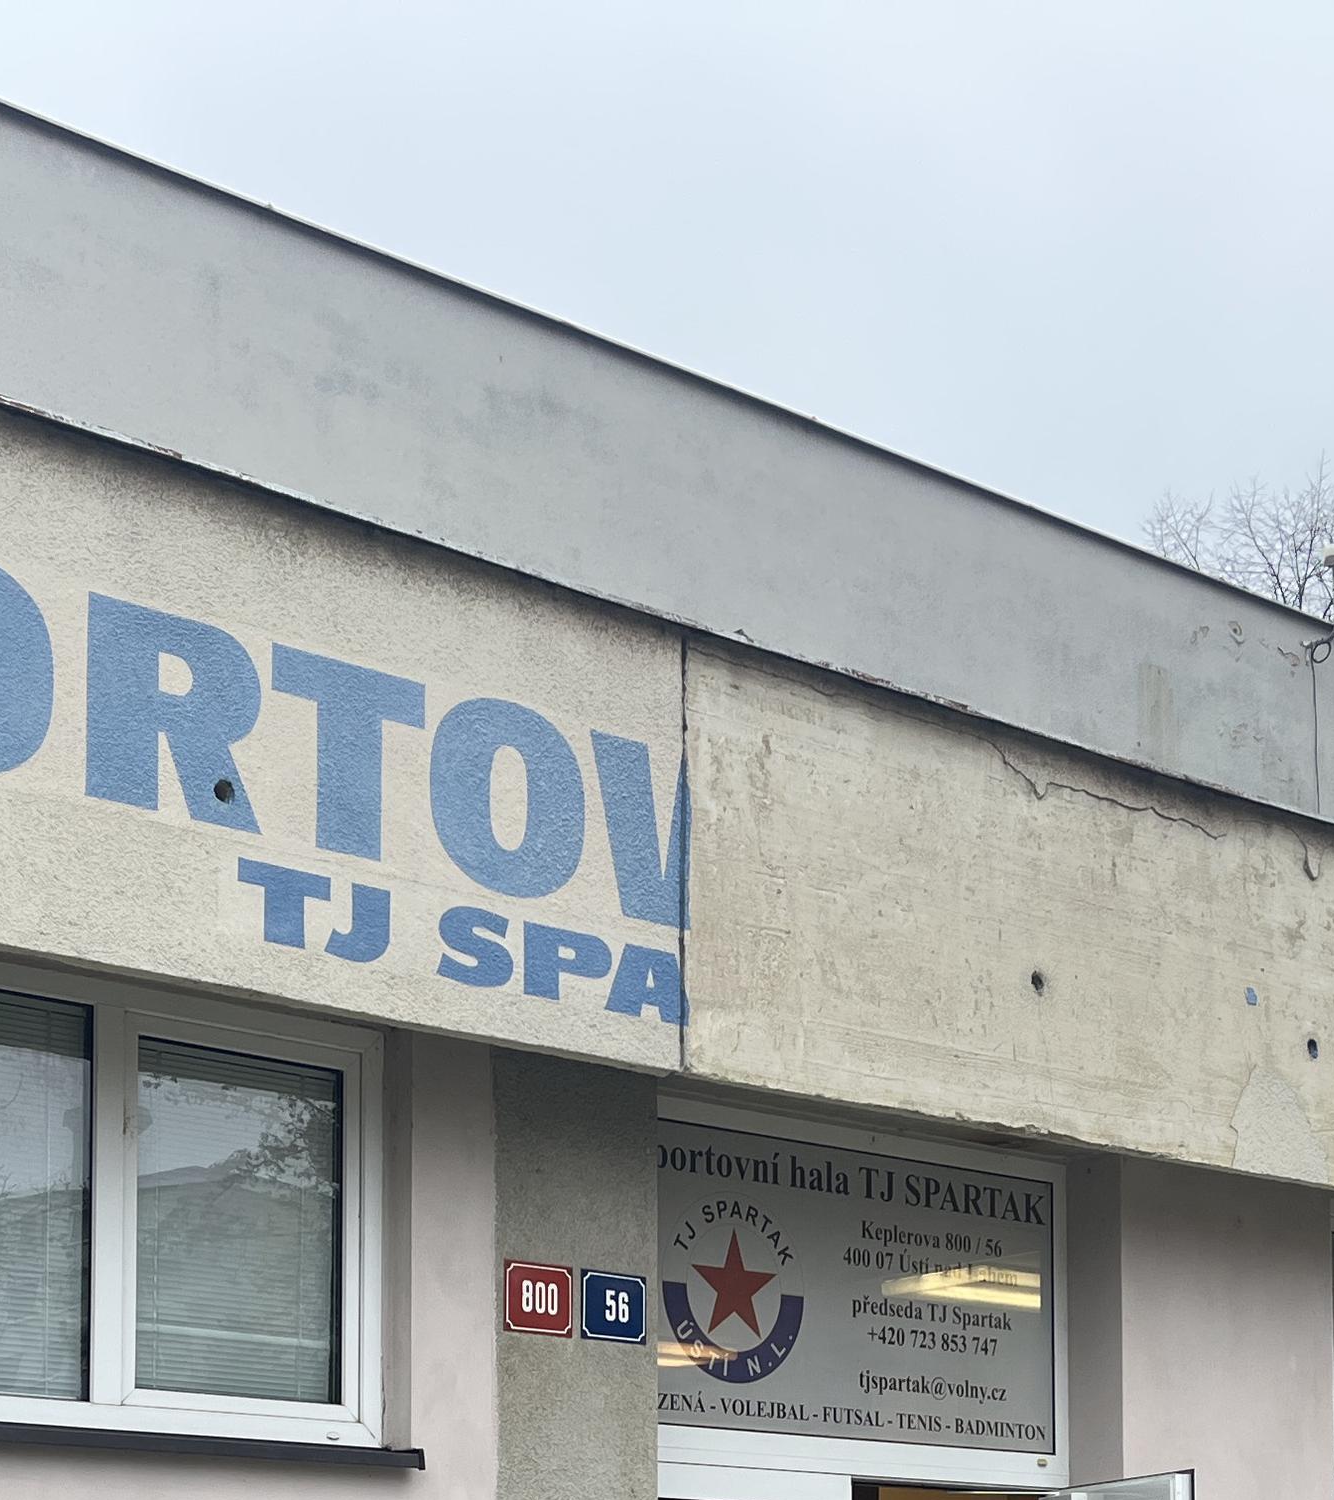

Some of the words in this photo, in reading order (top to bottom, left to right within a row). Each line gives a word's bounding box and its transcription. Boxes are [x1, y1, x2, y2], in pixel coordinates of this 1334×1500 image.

[237, 857, 390, 964] TJ
[436, 904, 689, 1026] SPA
[790, 1155, 850, 1195] hala
[858, 1167, 895, 1202] TJ
[905, 1174, 1046, 1226] SPARTAK
[673, 1221, 696, 1251] TJ
[702, 1200, 794, 1266] SPARTAK
[861, 1220, 941, 1249] Keplerova
[945, 1233, 971, 1252] 800
[985, 1238, 1002, 1257] 56
[843, 1246, 871, 1267] 400
[876, 1253, 894, 1270] 07
[899, 1249, 931, 1275] Ústí
[522, 1280, 558, 1316] 800
[605, 1289, 630, 1323] 56
[852, 1295, 922, 1320] předseda
[927, 1303, 947, 1324] TJ
[952, 1306, 1012, 1331] Spartak
[677, 1320, 729, 1376] ÚSTÍ
[867, 1325, 905, 1346] +420
[910, 1330, 936, 1350] 723
[941, 1333, 967, 1353] 853
[971, 1336, 998, 1356] 747
[859, 1369, 1007, 1404] tjspartak@volny.cz
[657, 1391, 705, 1413] ZENÁ
[720, 1398, 809, 1421] VOLEJBAL
[823, 1406, 884, 1427] FUTSAL
[897, 1413, 942, 1432] TENIS
[955, 1418, 1046, 1441] BADMINTON
